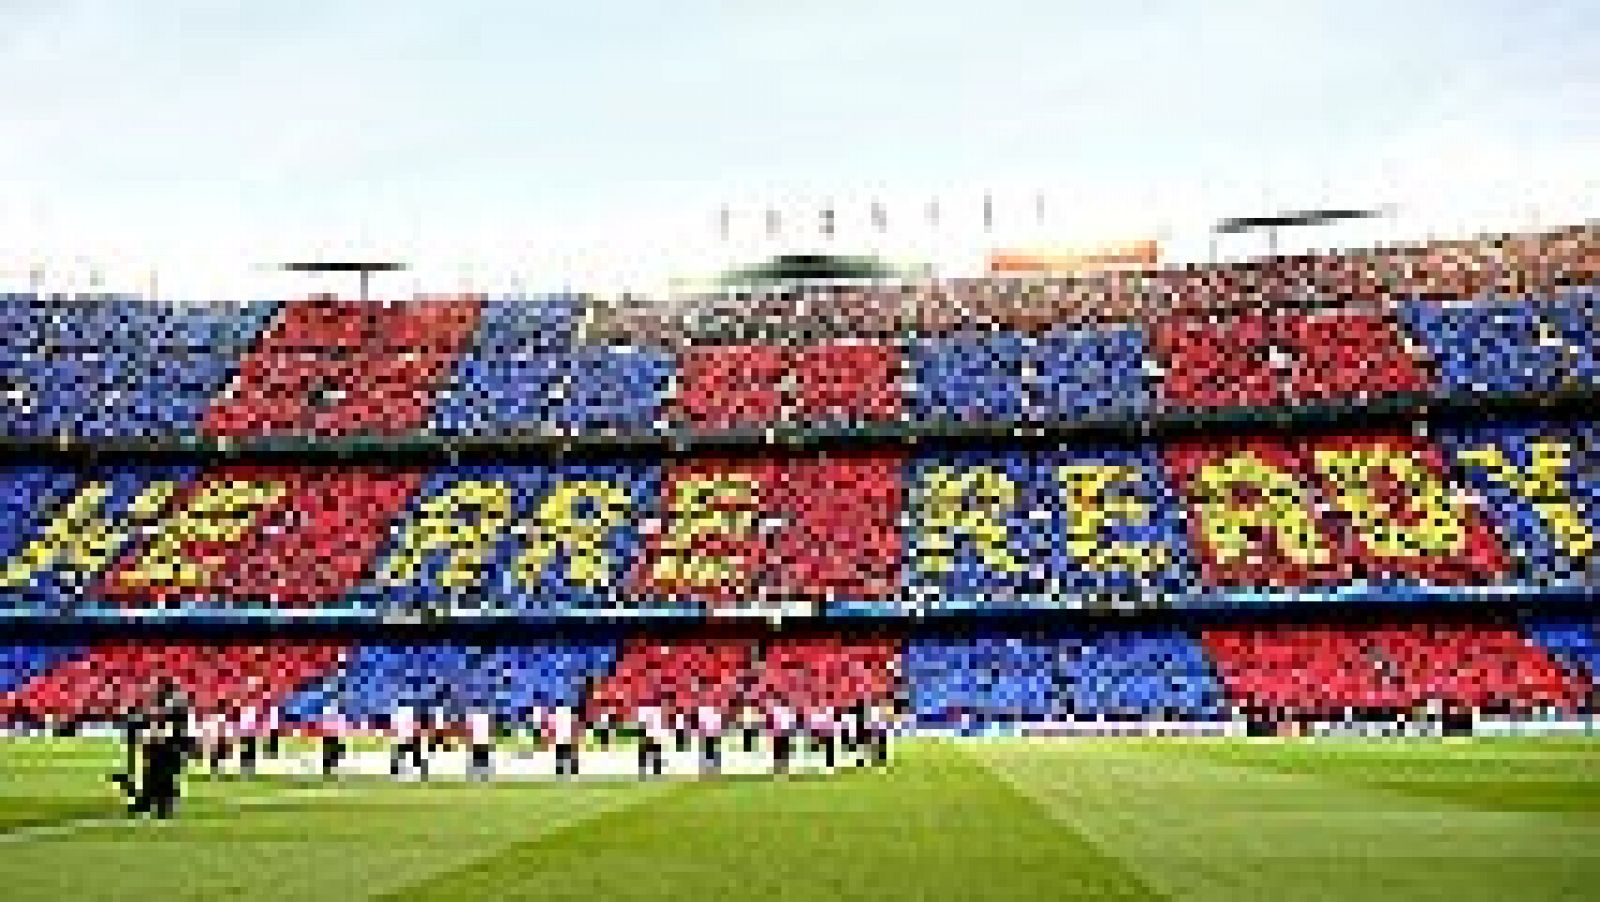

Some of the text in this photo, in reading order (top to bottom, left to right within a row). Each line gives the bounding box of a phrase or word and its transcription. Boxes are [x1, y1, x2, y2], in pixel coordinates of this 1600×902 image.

[0, 434, 1594, 588] WE ARE READY
